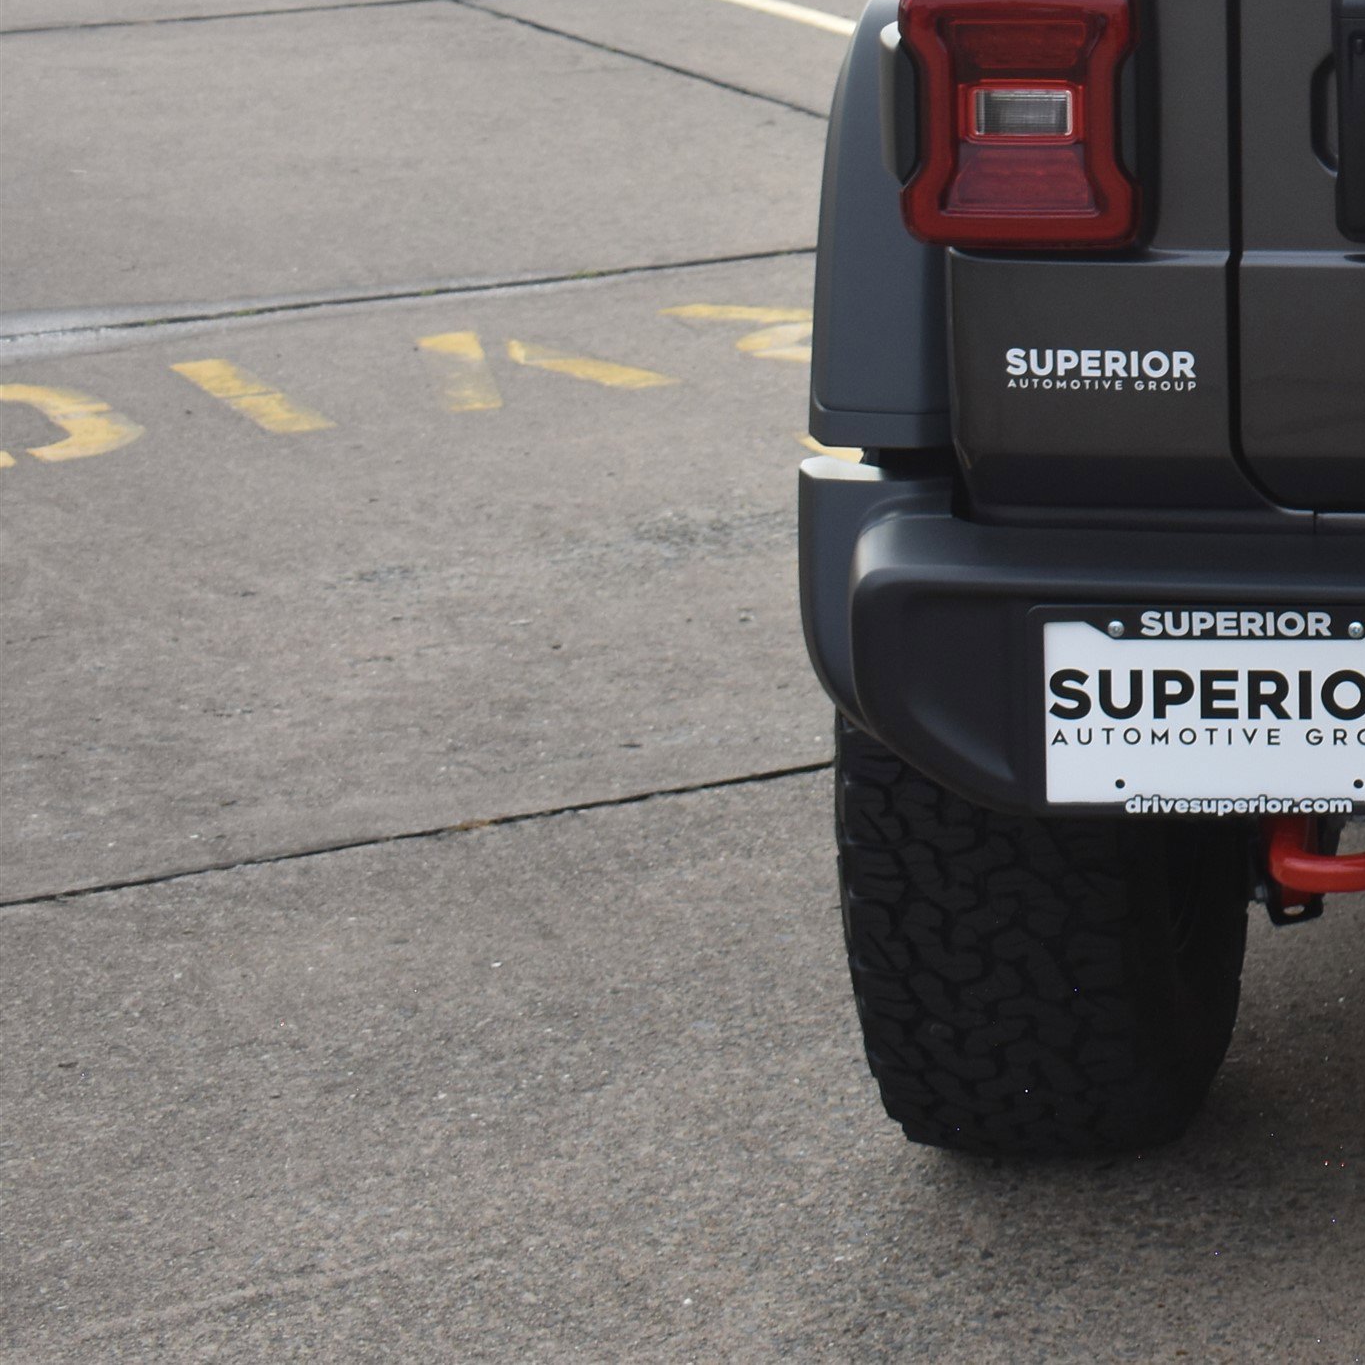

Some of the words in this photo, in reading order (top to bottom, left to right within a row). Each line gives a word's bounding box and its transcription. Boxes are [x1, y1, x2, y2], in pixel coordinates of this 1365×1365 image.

[1005, 348, 1197, 378] SUPERIOR
[1006, 378, 1124, 391] AUTOMOTIVE
[1134, 379, 1198, 392] GROUP
[1140, 611, 1332, 637] SUPERIOR
[1051, 727, 1282, 747] AUTOMOTIVE
[1124, 794, 1354, 817] drivesuperior.com
